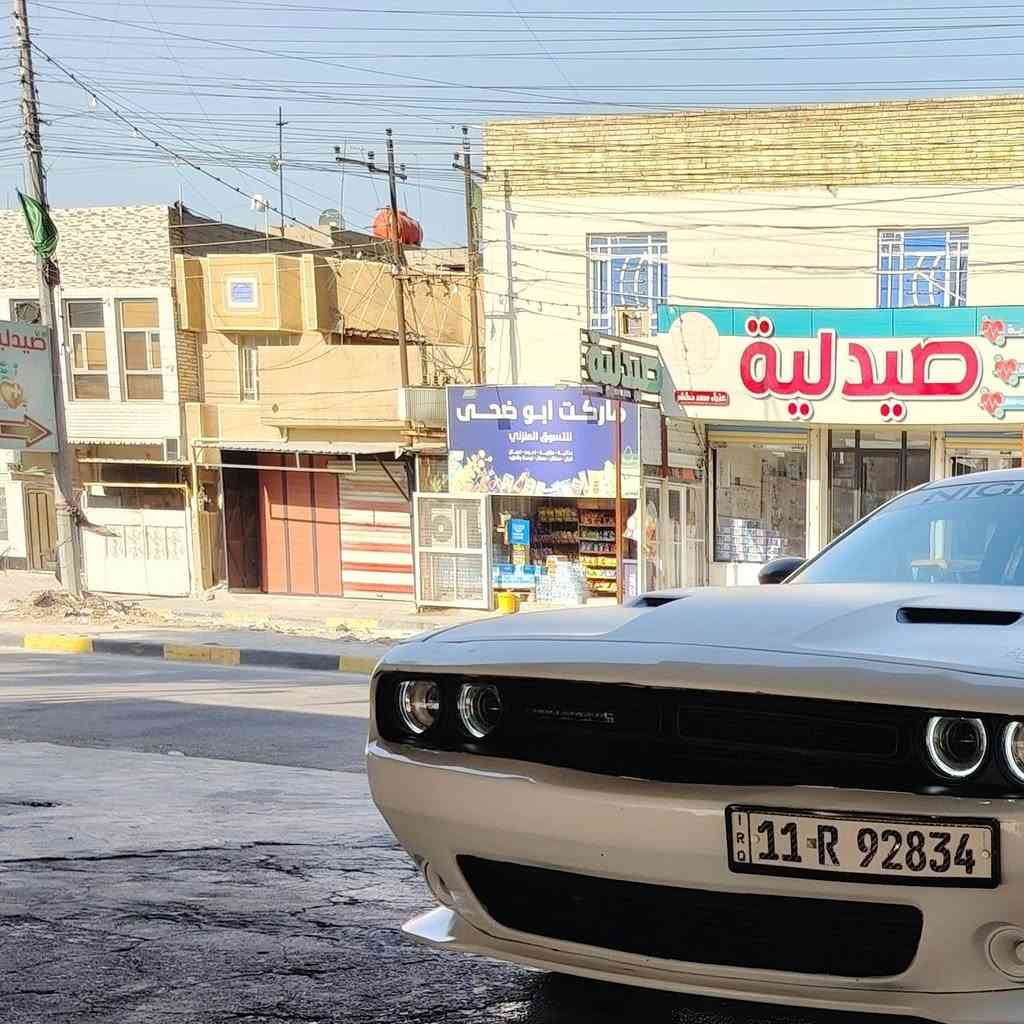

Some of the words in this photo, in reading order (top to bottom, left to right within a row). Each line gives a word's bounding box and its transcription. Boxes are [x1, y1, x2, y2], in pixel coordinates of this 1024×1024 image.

[739, 318, 981, 416] صيدلية
[522, 399, 553, 425] ابو
[558, 398, 626, 426] ماركت
[757, 820, 802, 863] 11
[817, 824, 840, 866] R
[856, 827, 976, 875] 92834
